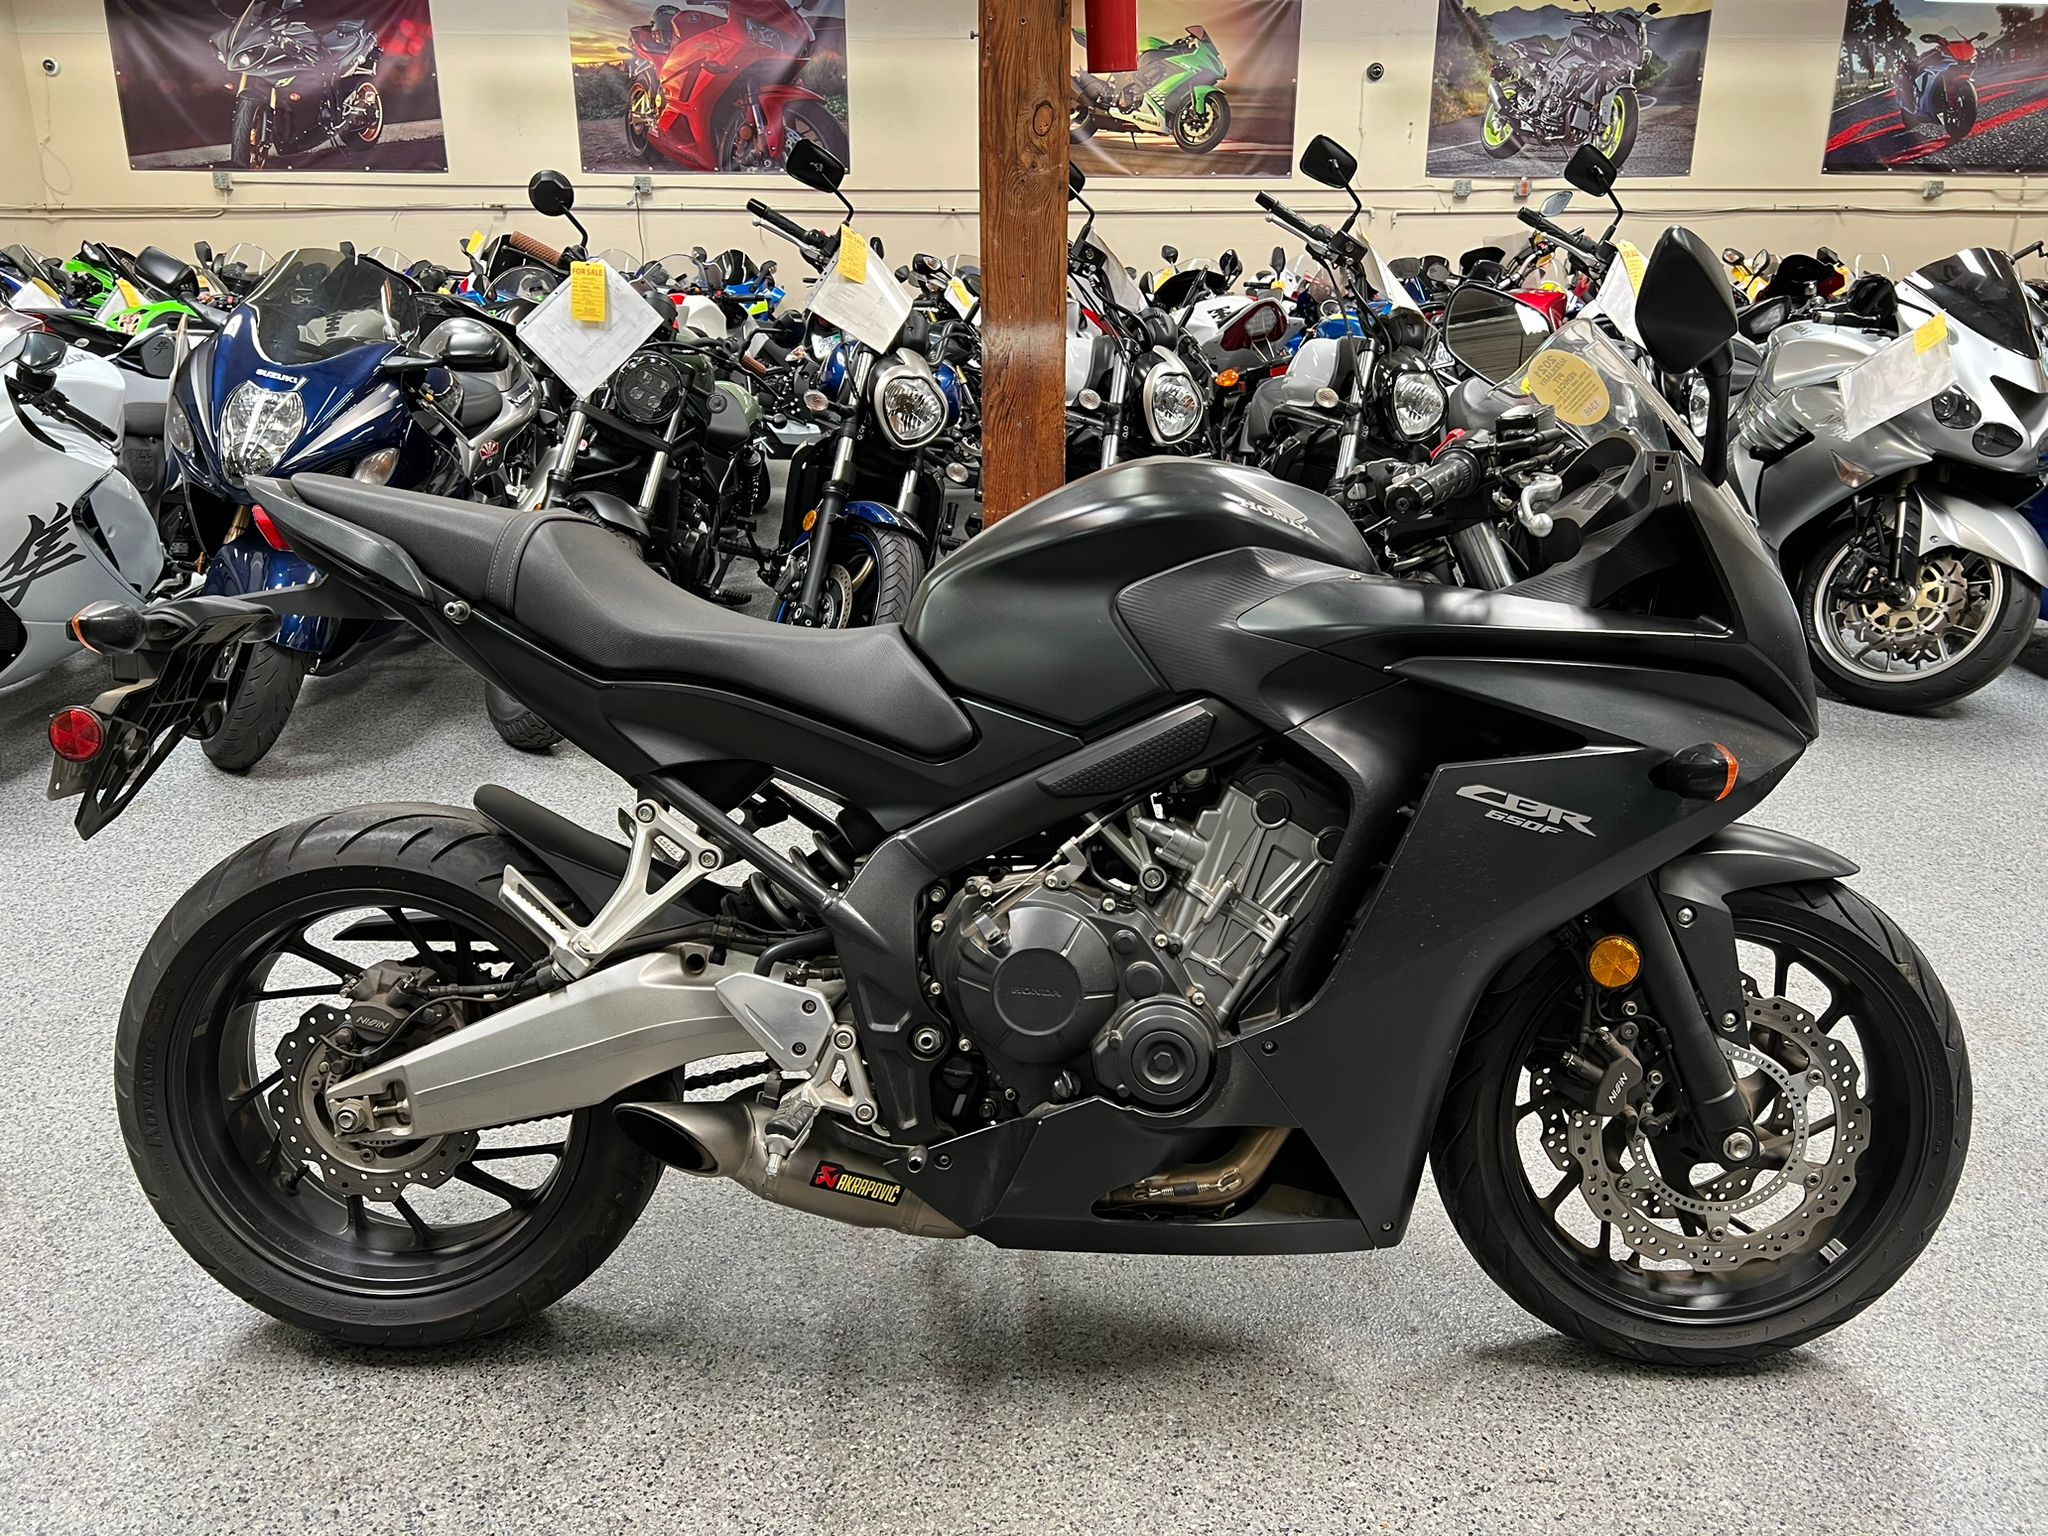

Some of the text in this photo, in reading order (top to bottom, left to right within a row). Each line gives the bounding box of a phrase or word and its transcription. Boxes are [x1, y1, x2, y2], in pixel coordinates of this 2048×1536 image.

[587, 269, 603, 277] SALE
[256, 369, 298, 384] SUZUKI
[1239, 500, 1320, 539] HONDA
[1456, 784, 1597, 838] CBR
[1485, 809, 1564, 834] 650F
[1009, 985, 1063, 999] HONDA
